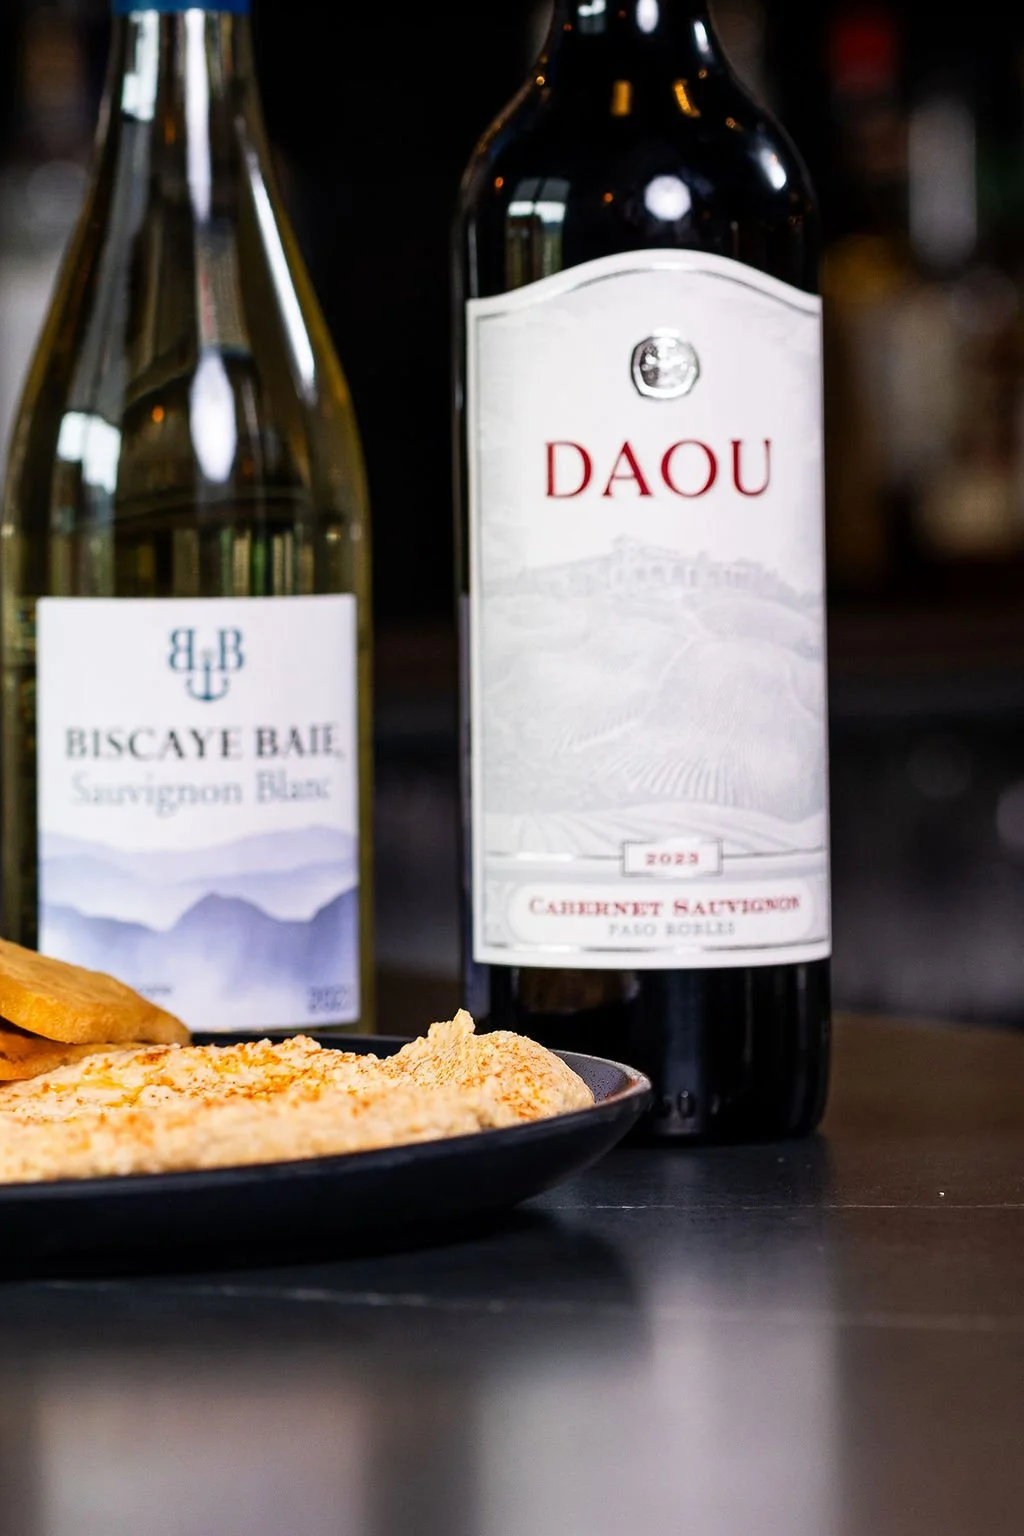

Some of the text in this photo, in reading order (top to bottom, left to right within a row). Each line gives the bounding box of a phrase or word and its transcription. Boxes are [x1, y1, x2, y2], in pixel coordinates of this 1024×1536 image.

[545, 437, 772, 499] DAOU
[64, 724, 243, 761] BISCAYE
[70, 766, 331, 818] Sauvignon Blanc
[644, 851, 701, 866] 2023
[607, 922, 657, 937] PASO
